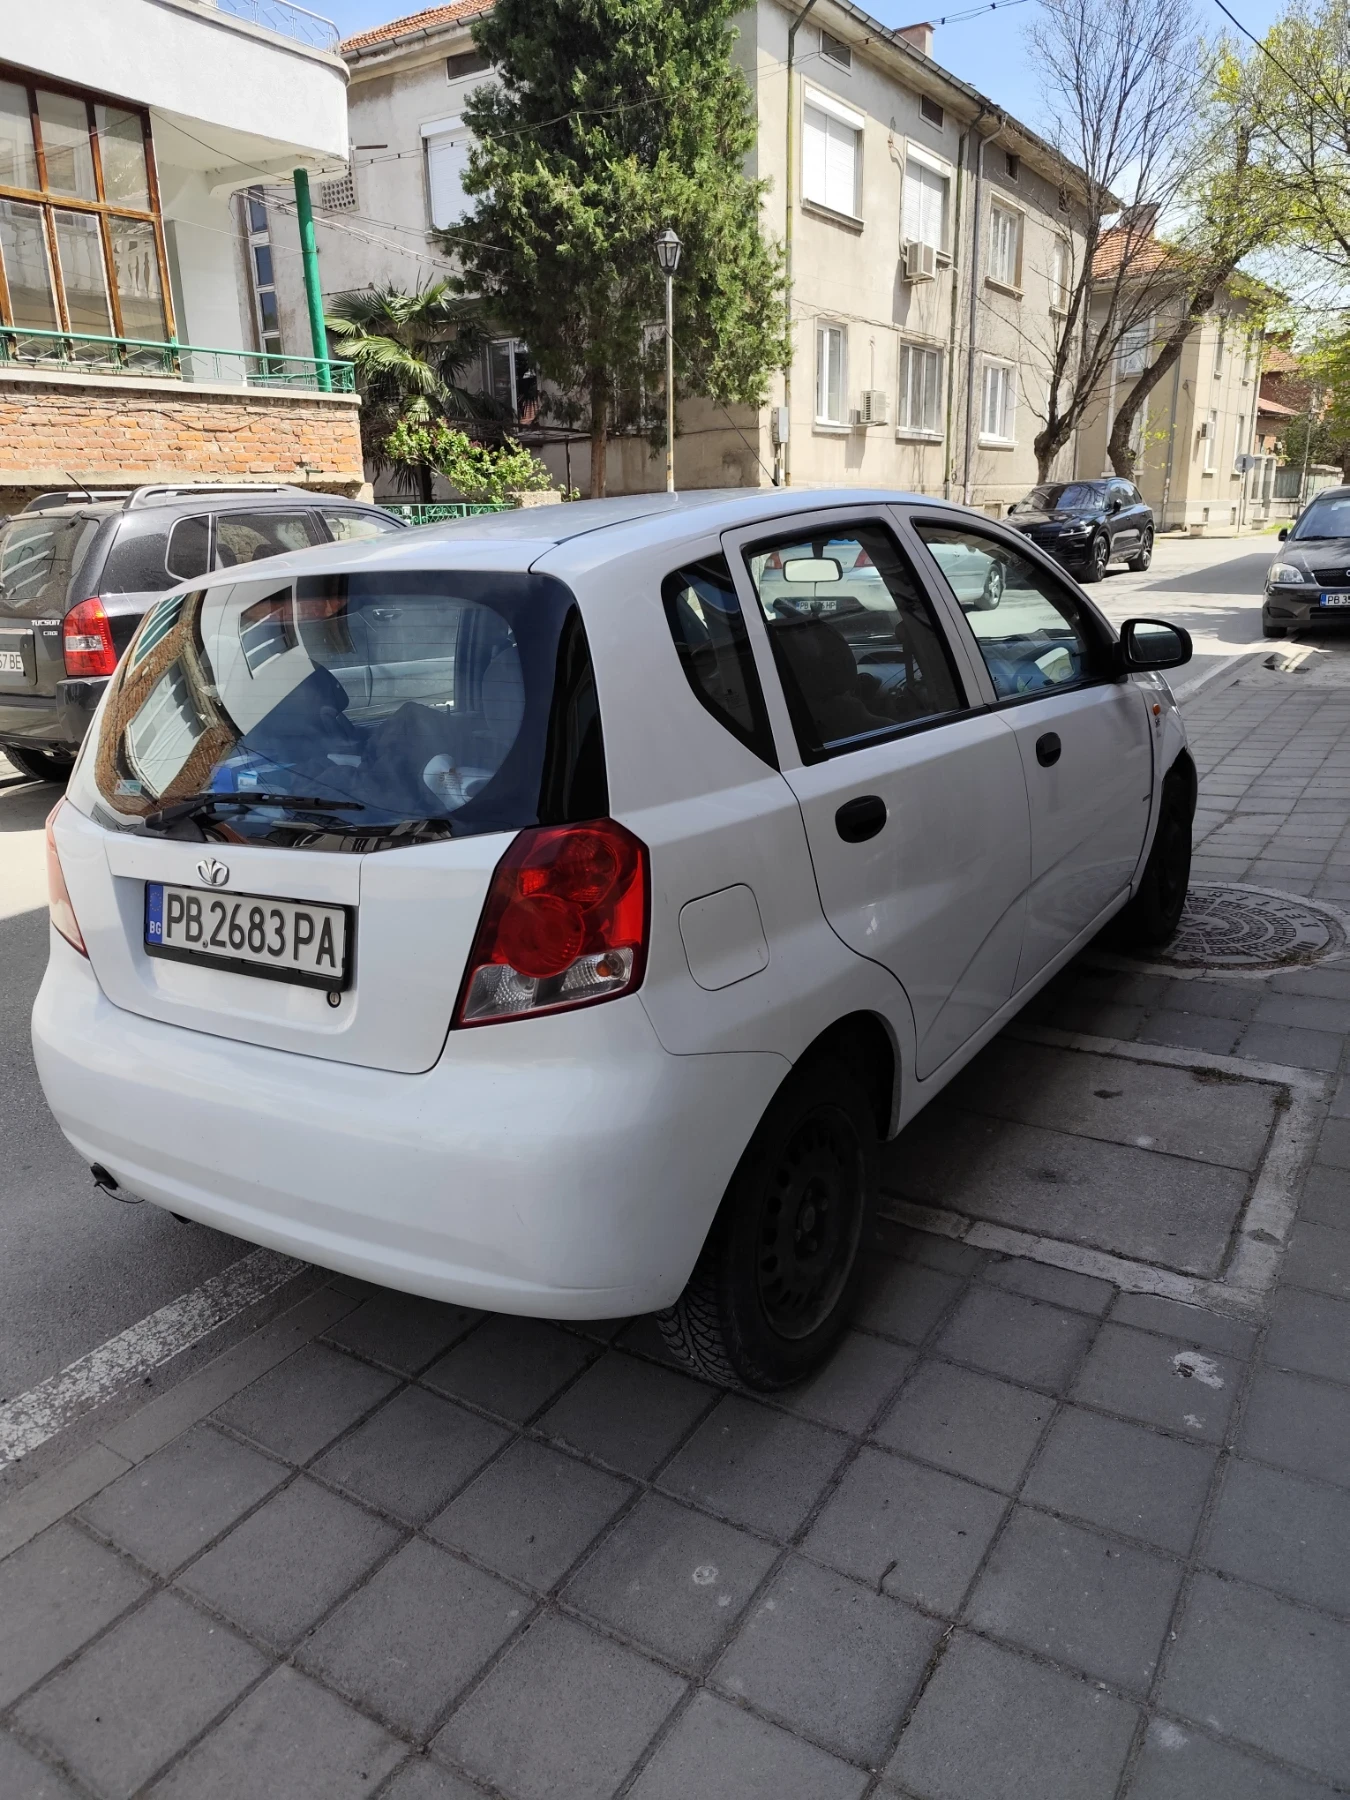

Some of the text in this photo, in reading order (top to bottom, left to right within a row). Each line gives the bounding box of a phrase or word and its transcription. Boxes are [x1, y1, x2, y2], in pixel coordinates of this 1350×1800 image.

[1327, 595, 1340, 604] PB
[10, 655, 22, 670] BE
[149, 920, 162, 935] BG
[166, 893, 337, 969] PB 2683 PA
